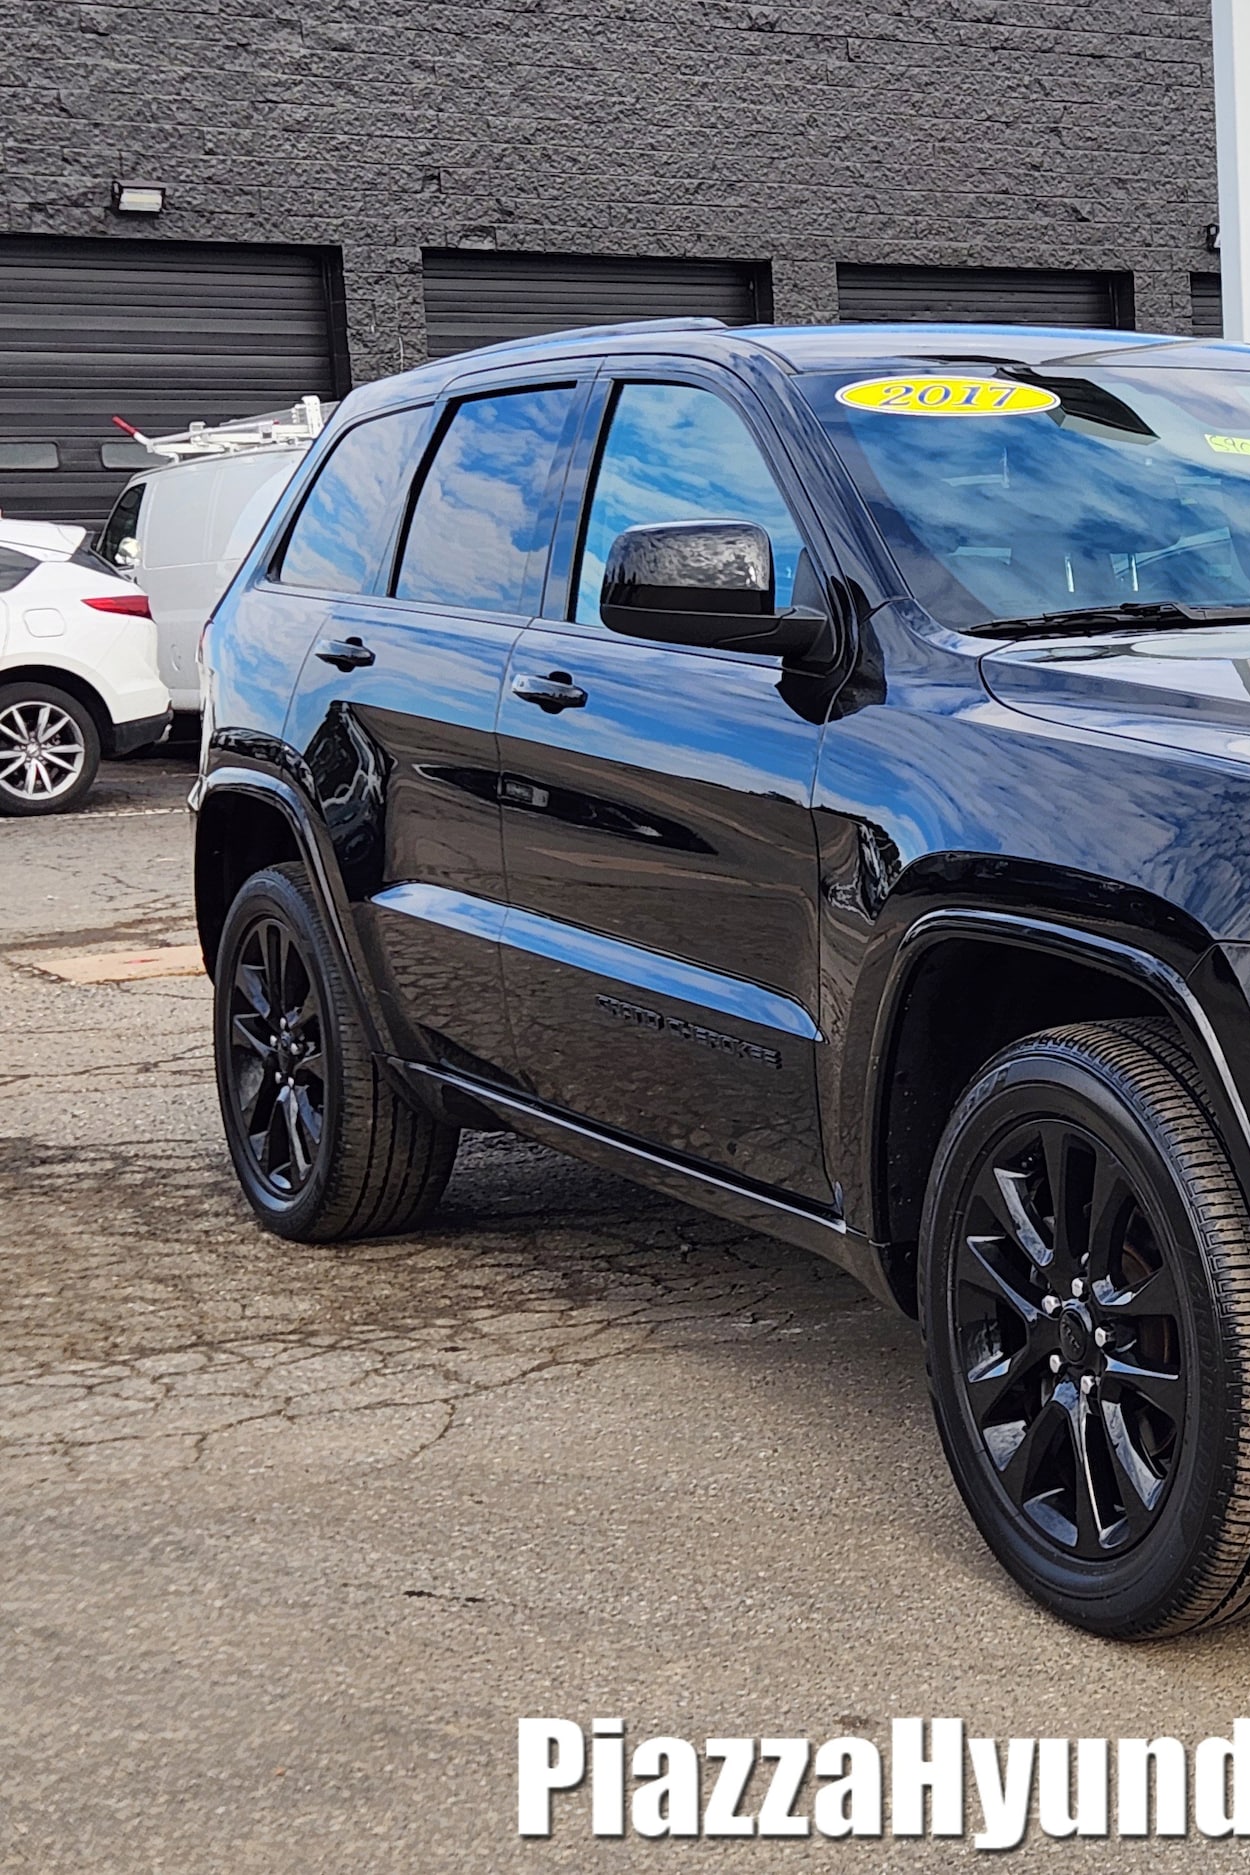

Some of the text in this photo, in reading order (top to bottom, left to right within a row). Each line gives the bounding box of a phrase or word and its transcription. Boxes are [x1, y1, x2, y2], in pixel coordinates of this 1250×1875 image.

[879, 385, 1017, 408] 2017
[595, 993, 782, 1070] GRAND CHEROKEE
